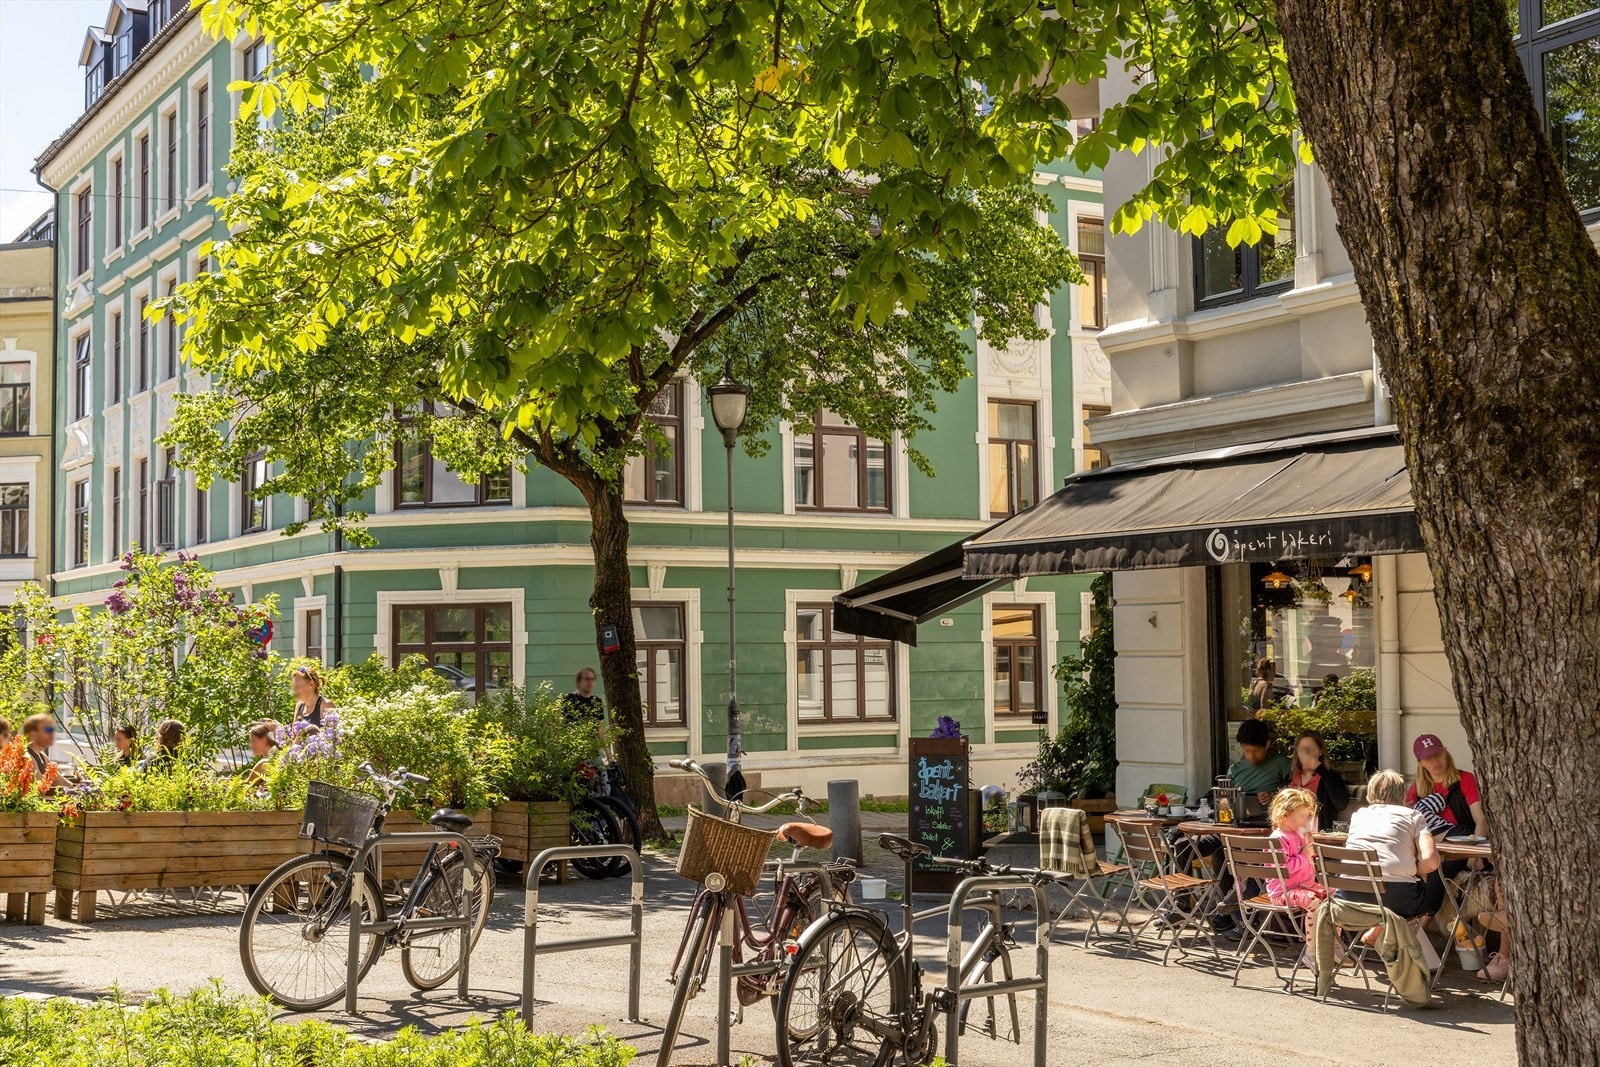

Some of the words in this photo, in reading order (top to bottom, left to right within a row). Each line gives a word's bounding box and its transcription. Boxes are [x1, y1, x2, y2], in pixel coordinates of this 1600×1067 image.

[1233, 529, 1277, 562] åpent
[1281, 529, 1332, 550] bakeri
[1421, 737, 1434, 749] H
